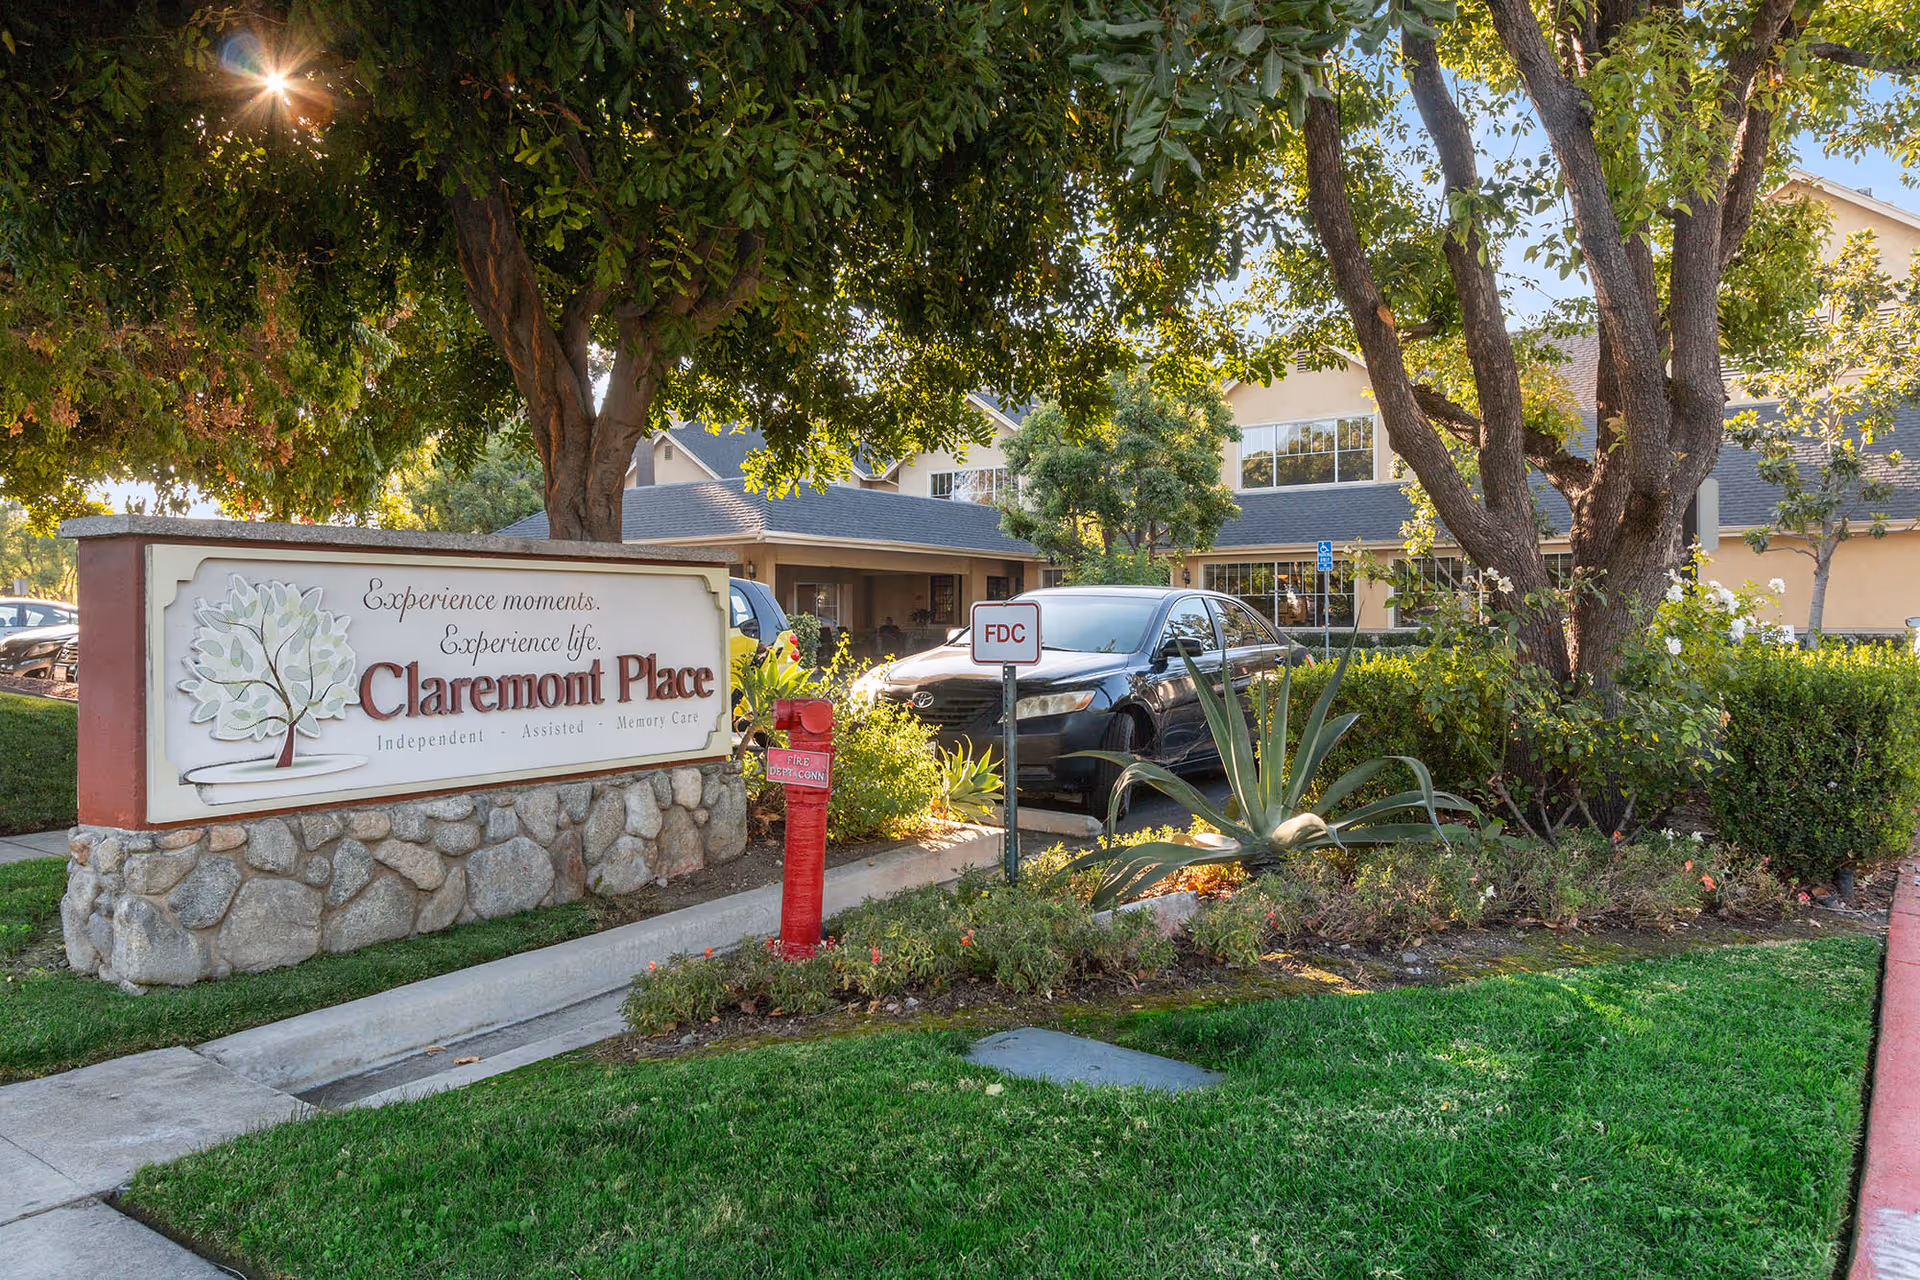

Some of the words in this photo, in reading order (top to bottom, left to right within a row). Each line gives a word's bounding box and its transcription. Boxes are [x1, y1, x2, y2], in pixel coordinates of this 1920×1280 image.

[363, 578, 497, 622] Experience
[502, 591, 600, 611] moments.
[440, 623, 562, 666] Experience
[566, 623, 601, 662] life.
[985, 623, 1025, 643] FDC
[359, 660, 606, 721] Claremont
[617, 652, 714, 704] Place
[377, 729, 484, 752] Independent
[522, 720, 584, 739] Assisted
[617, 714, 666, 730] Memory
[671, 711, 699, 725] Care
[769, 767, 794, 777] DEPT
[797, 770, 825, 780] CONN
[786, 754, 810, 766] FIRE
